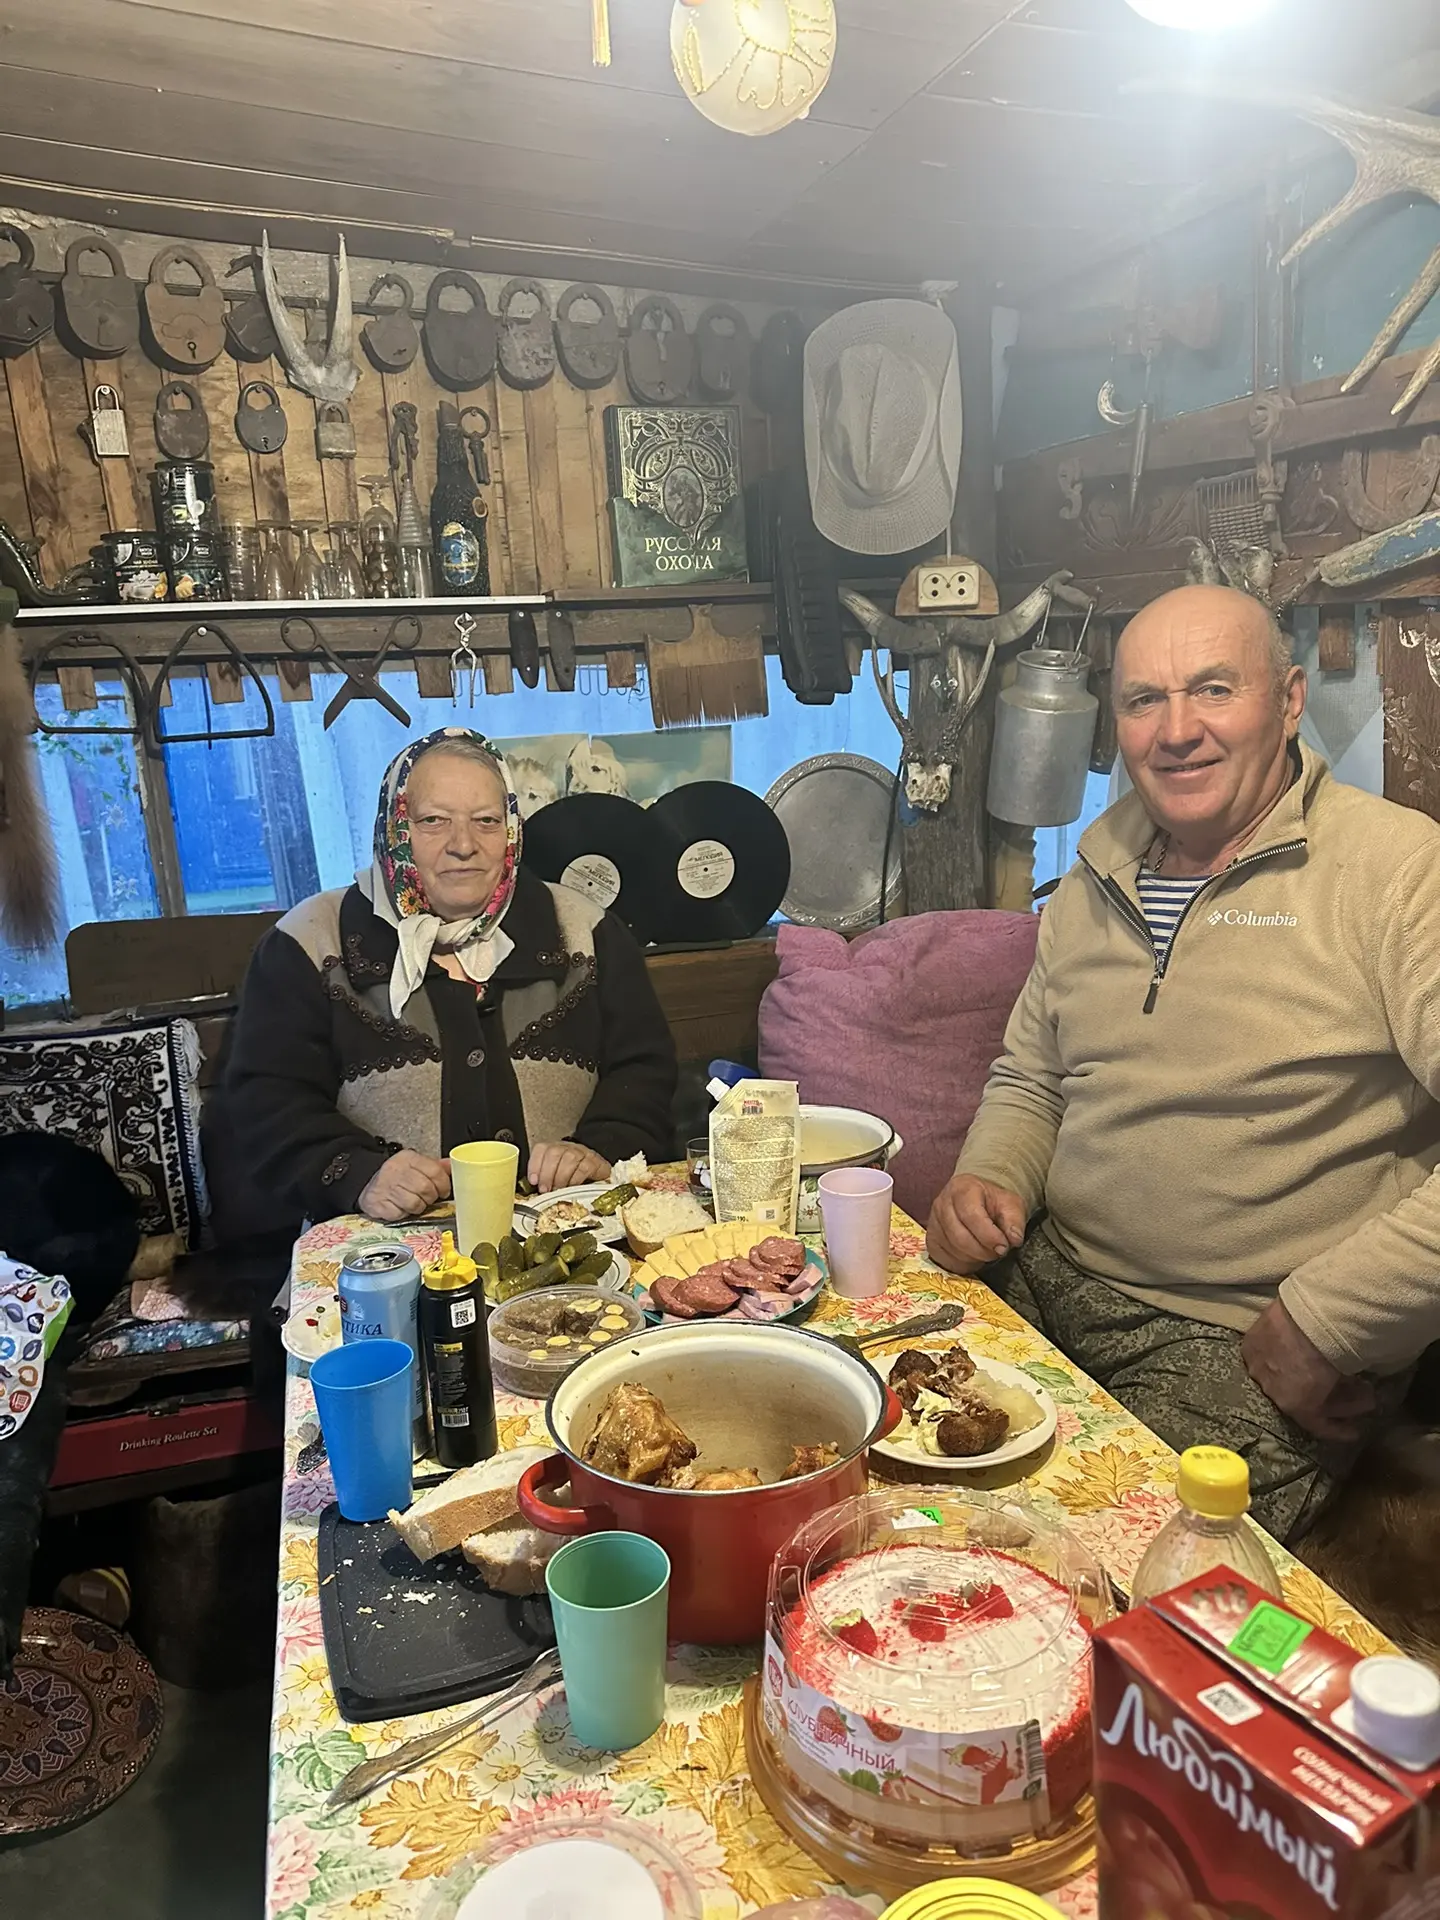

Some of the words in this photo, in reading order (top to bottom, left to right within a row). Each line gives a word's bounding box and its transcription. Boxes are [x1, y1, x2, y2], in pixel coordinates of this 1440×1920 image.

[655, 554, 715, 571] ОХОТА
[1223, 908, 1298, 927] Columbia
[342, 1319, 384, 1336] ТИКА
[119, 1437, 162, 1452] Drinking
[163, 1430, 201, 1444] Roulette
[202, 1425, 218, 1436] Set
[787, 1696, 896, 1771] КЛУБНИЧНЫЙ
[1100, 1682, 1340, 1912] Любимый
